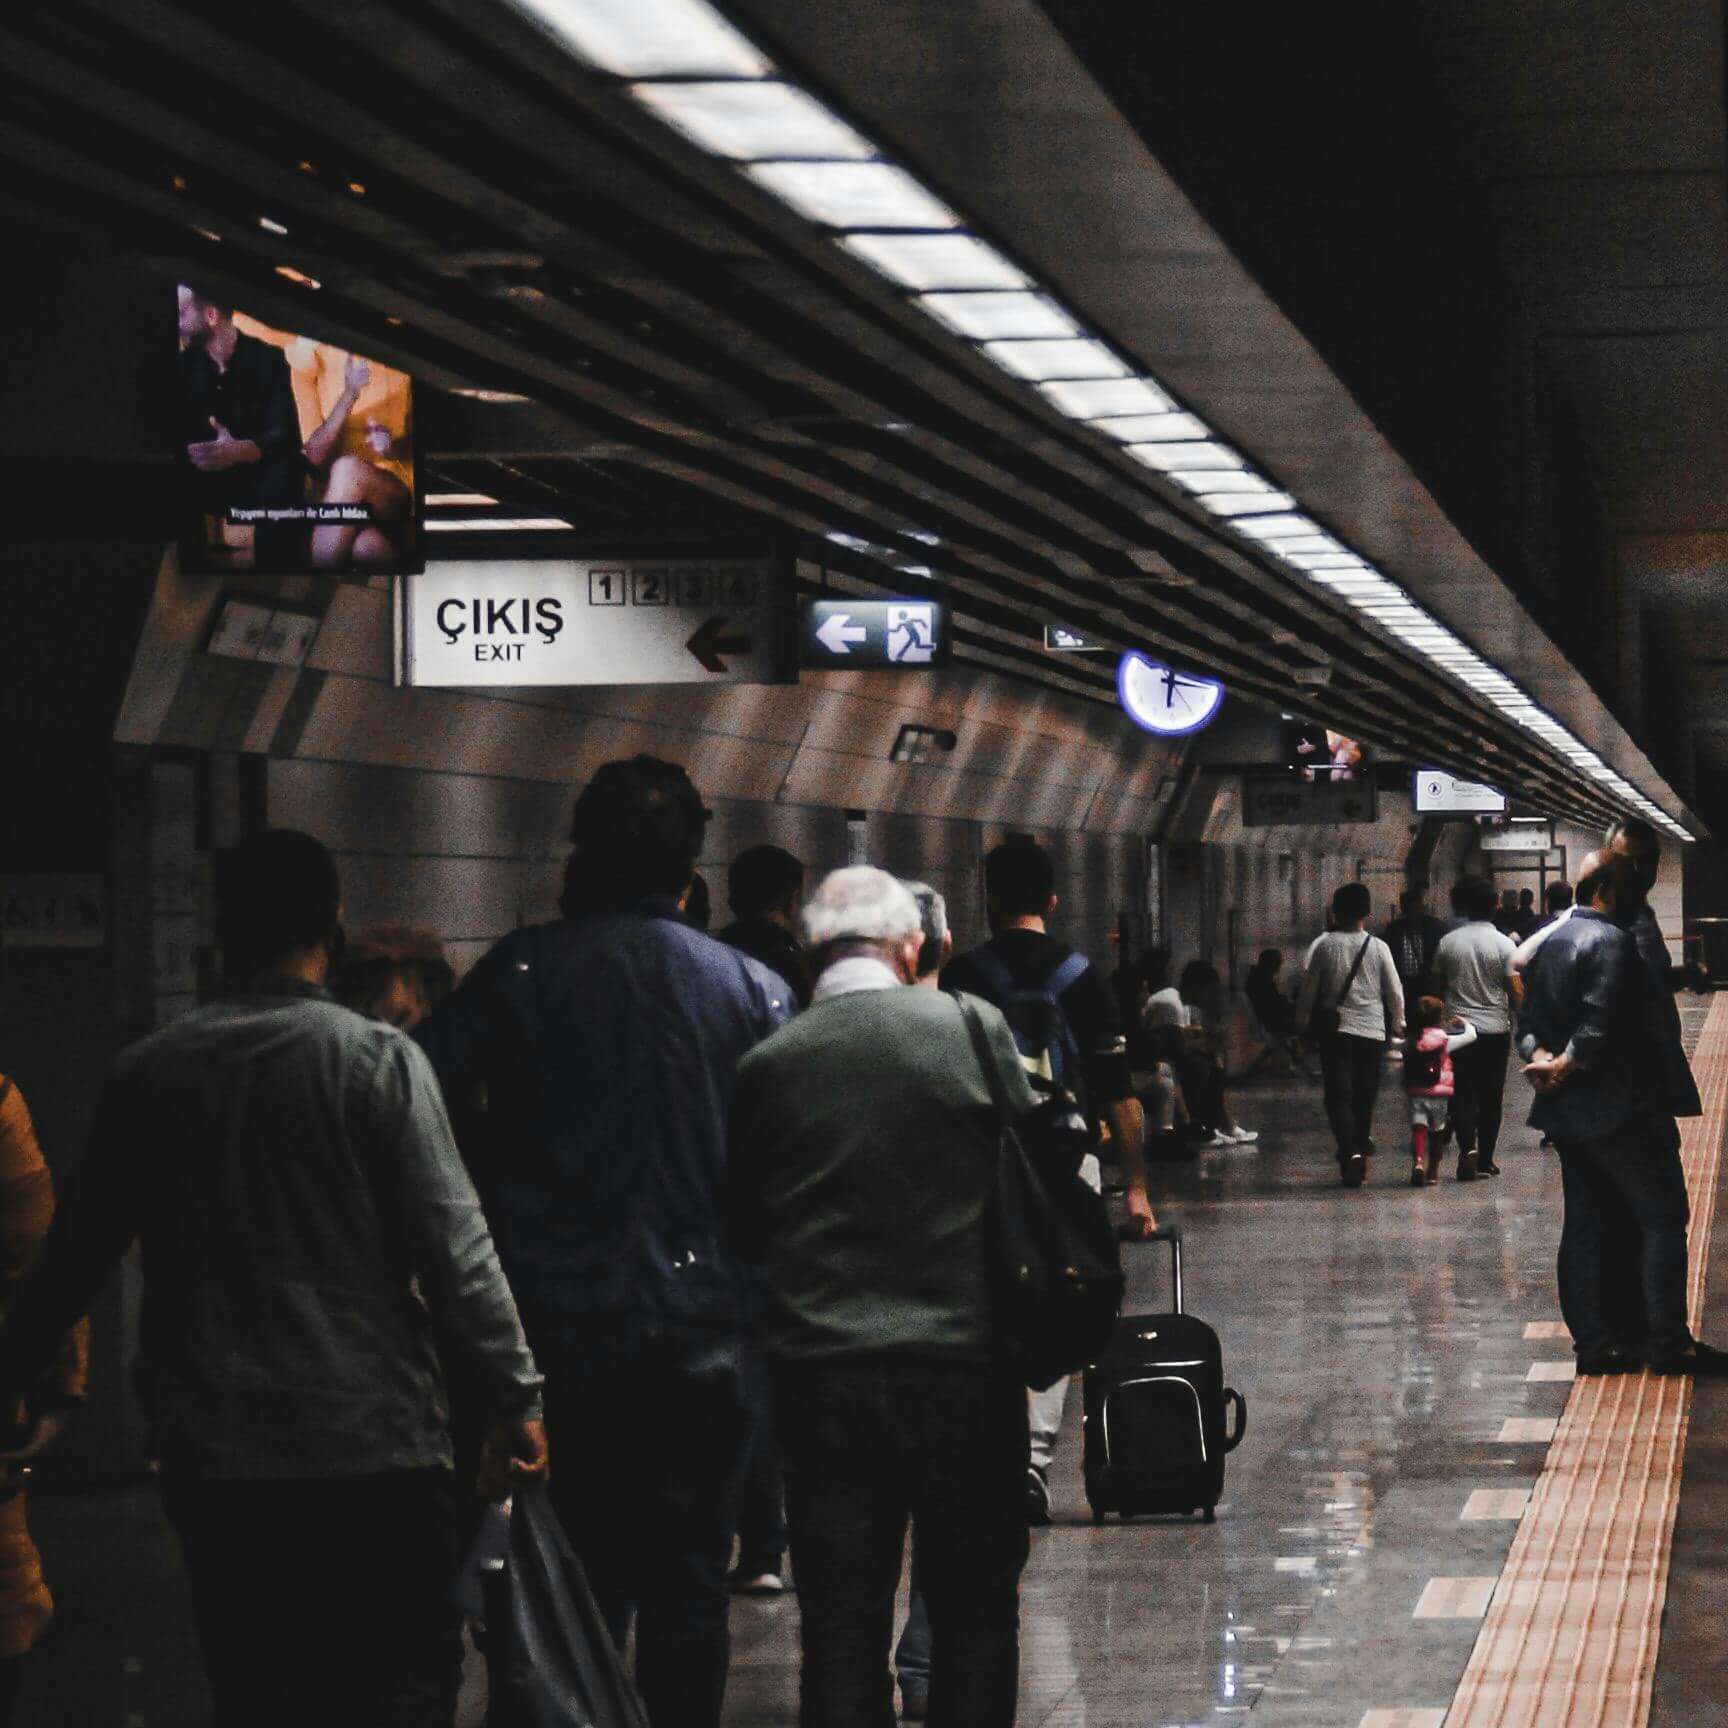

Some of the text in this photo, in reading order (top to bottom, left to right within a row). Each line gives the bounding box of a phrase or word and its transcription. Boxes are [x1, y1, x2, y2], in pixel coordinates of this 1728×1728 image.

[600, 575, 611, 600] 1
[643, 575, 658, 600] 2
[685, 575, 701, 600] 3
[437, 597, 564, 645] ÇIKIŞ
[474, 645, 525, 662] EXIT
